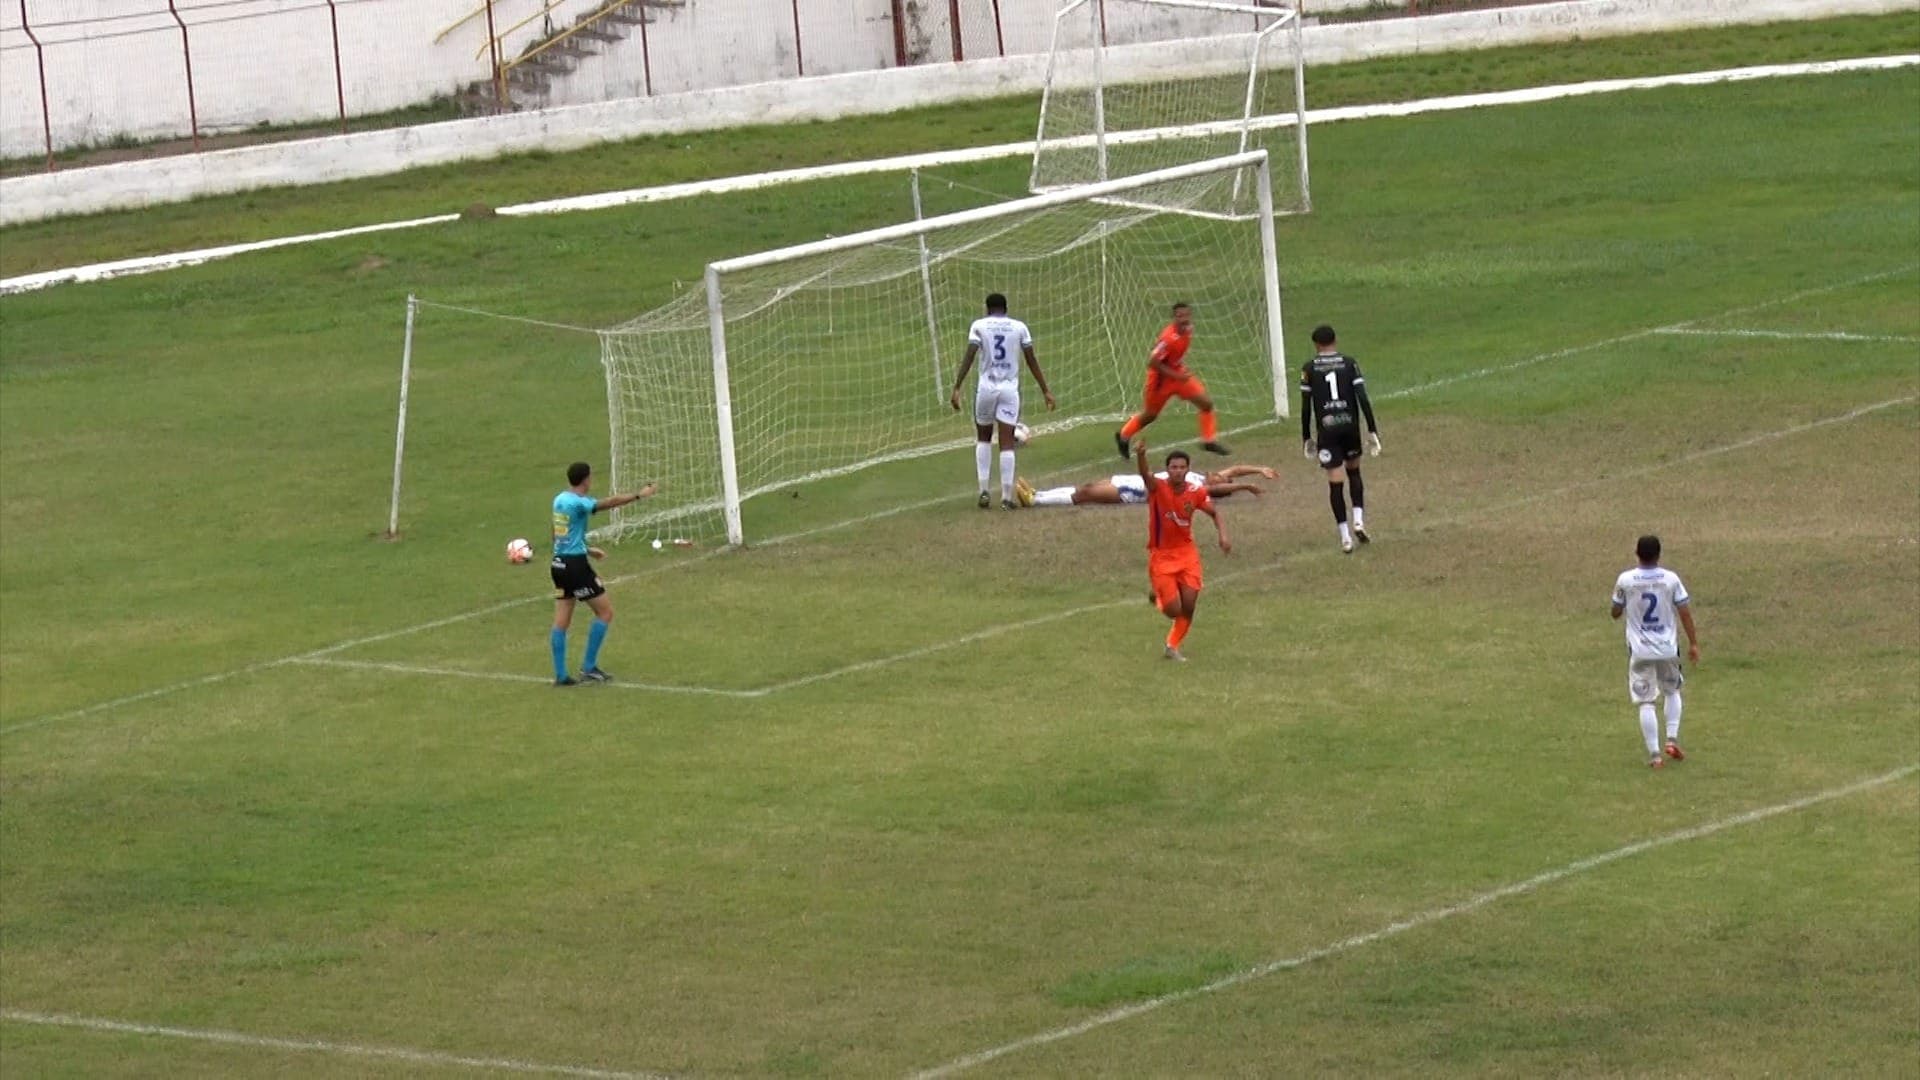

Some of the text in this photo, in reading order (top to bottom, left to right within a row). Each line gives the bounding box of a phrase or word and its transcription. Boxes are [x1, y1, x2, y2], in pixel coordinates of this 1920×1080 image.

[993, 334, 1006, 361] 3
[1324, 371, 1339, 401] 1
[1641, 592, 1659, 624] 2
